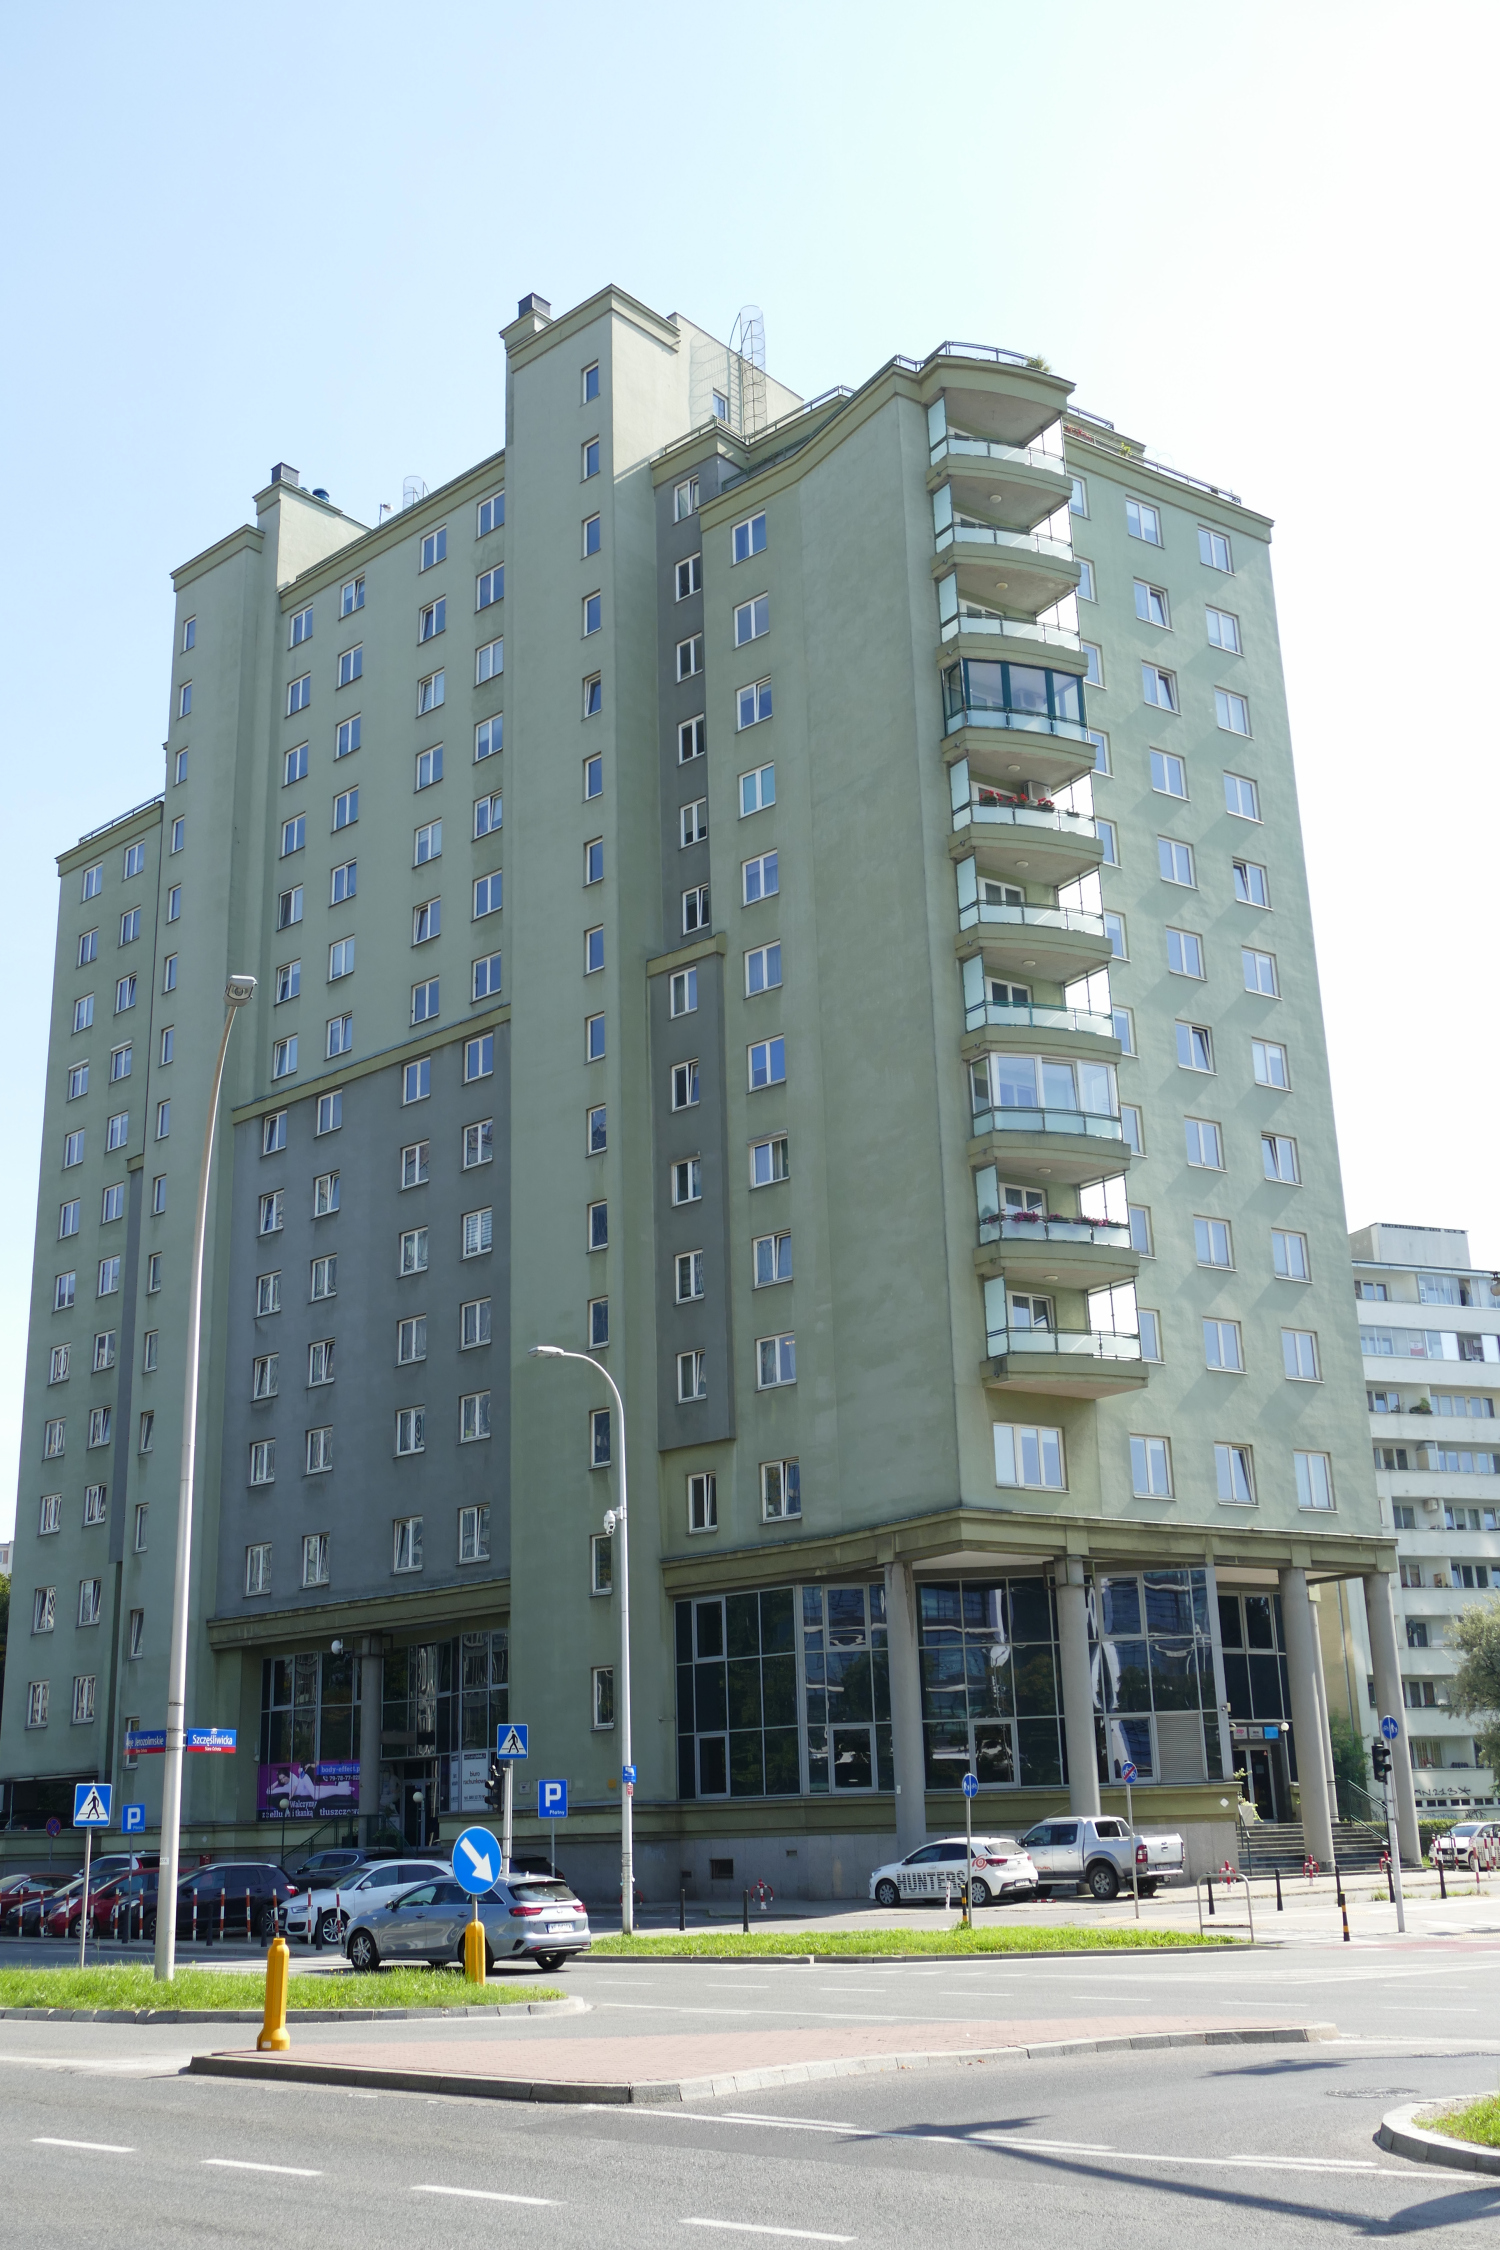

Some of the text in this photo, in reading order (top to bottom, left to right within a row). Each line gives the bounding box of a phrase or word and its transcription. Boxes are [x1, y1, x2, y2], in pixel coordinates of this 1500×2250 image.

[192, 1734, 233, 1746] Szczęśliwicka
[321, 1765, 360, 1774] body-effect.p
[545, 1783, 562, 1807] P
[127, 1807, 140, 1829] P
[897, 1870, 965, 1892] HUNTERS
